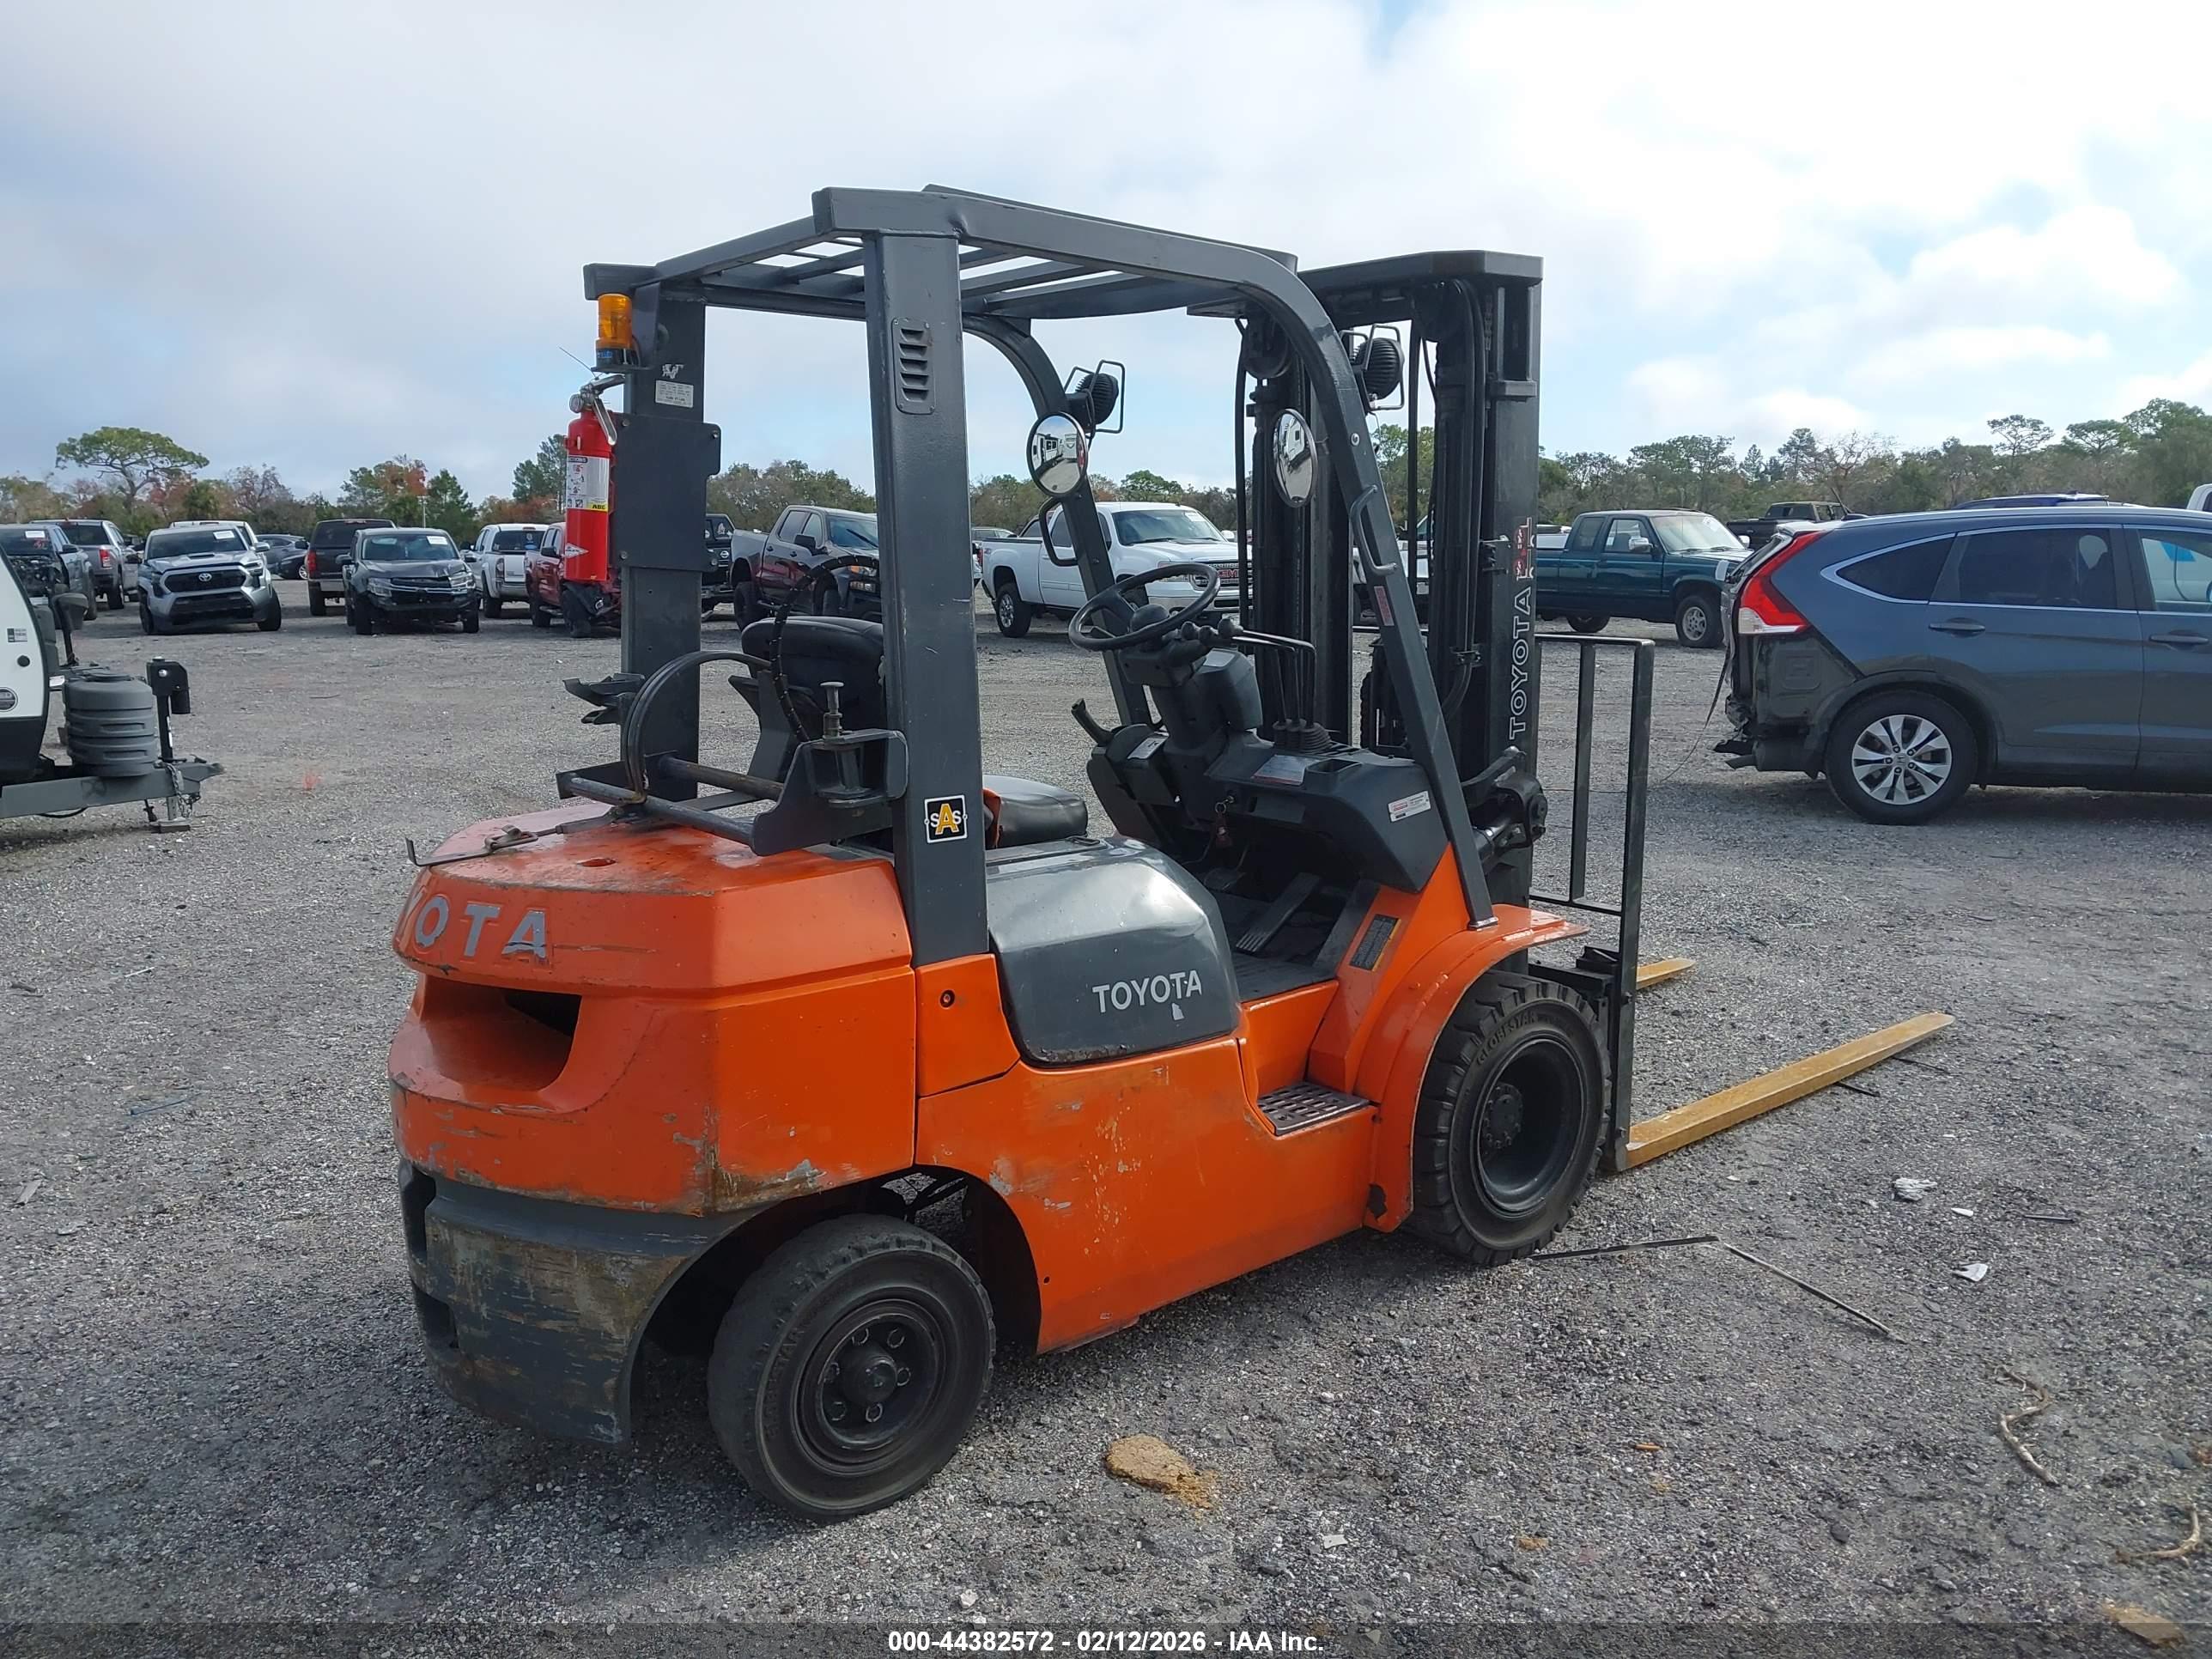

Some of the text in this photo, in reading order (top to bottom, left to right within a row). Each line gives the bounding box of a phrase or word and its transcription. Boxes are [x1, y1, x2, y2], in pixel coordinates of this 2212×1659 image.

[1217, 568, 1239, 578] GM
[1509, 586, 1532, 740] TOYOTA
[930, 803, 962, 836] SAS
[1091, 969, 1202, 1013] TOYOTA
